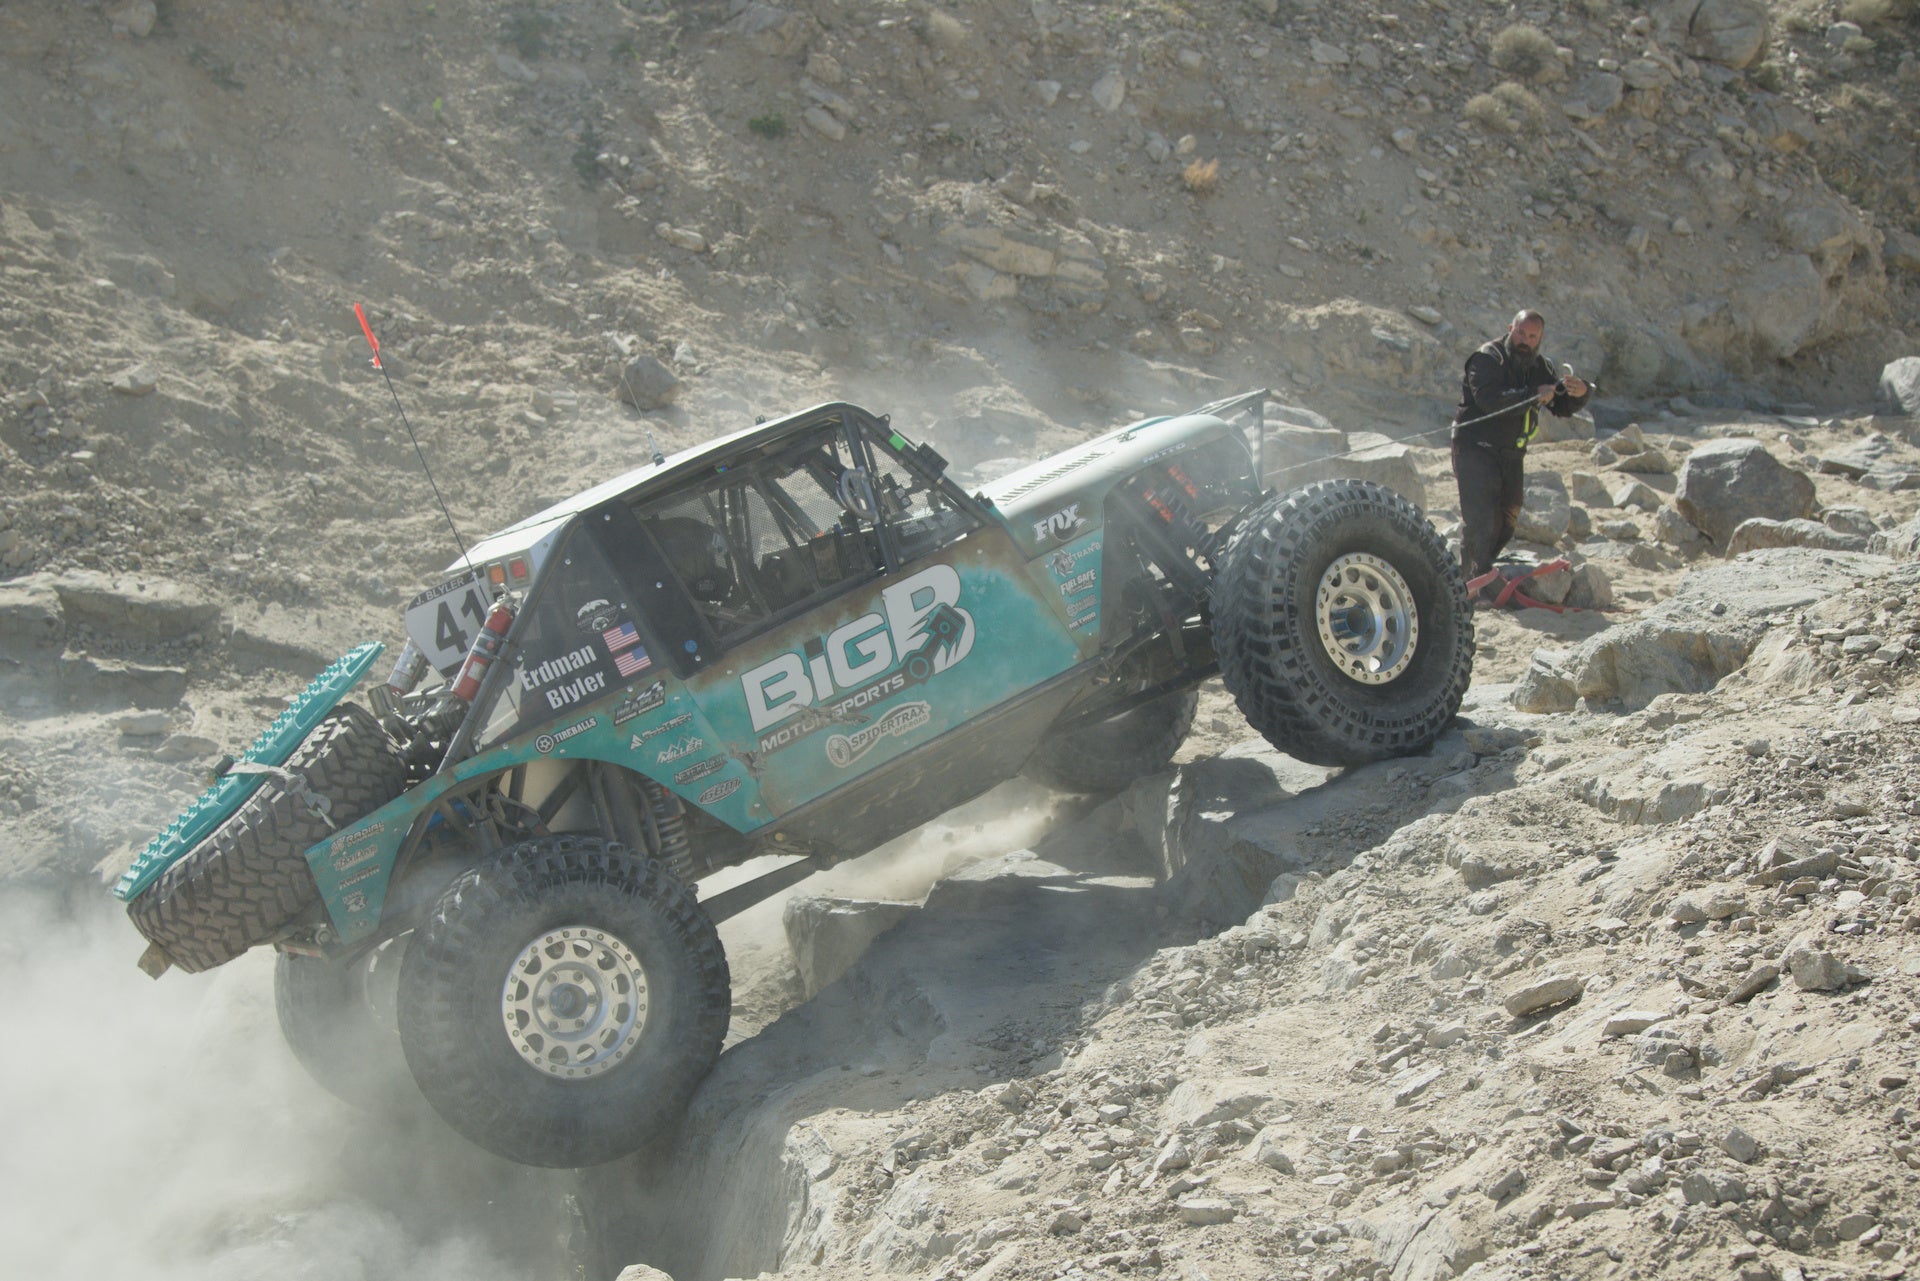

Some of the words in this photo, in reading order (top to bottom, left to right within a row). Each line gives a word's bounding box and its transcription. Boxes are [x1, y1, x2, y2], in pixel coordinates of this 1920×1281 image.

[1033, 503, 1080, 541] FOX
[425, 577, 465, 601] BLYLER
[1060, 577, 1077, 596] FUEL
[1077, 568, 1097, 585] SAFE
[435, 588, 487, 654] 41
[519, 645, 598, 692] Erdman
[545, 671, 606, 711] Blyler
[553, 718, 598, 744] TIREBALLS
[761, 673, 905, 753] MOTOSPORTS
[851, 703, 927, 748] SPIDERTRAX
[658, 738, 703, 764] MILLER
